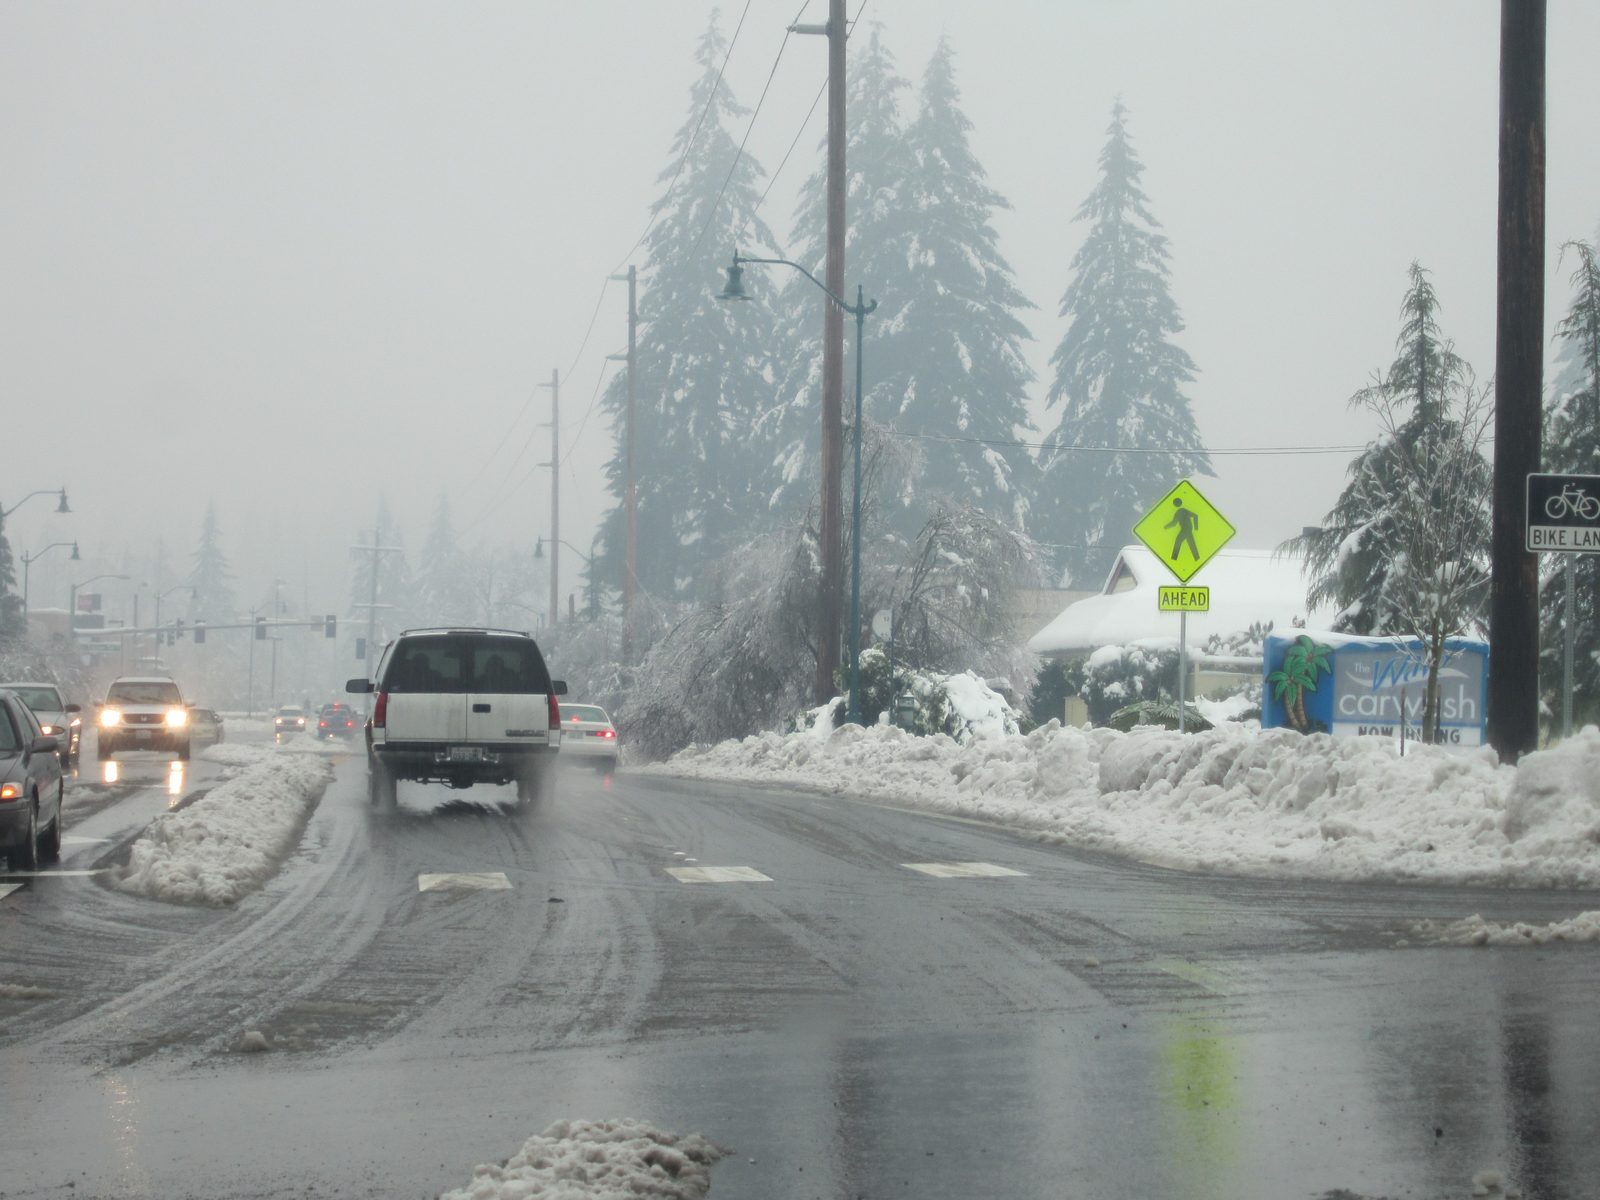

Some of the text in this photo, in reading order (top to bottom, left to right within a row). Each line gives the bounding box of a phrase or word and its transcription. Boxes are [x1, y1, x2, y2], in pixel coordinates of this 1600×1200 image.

[1533, 529, 1567, 545] BIKE
[1161, 591, 1207, 606] AHEAD
[1354, 662, 1371, 673] The
[1338, 683, 1476, 719] carwsh
[1357, 725, 1394, 737] NOW
